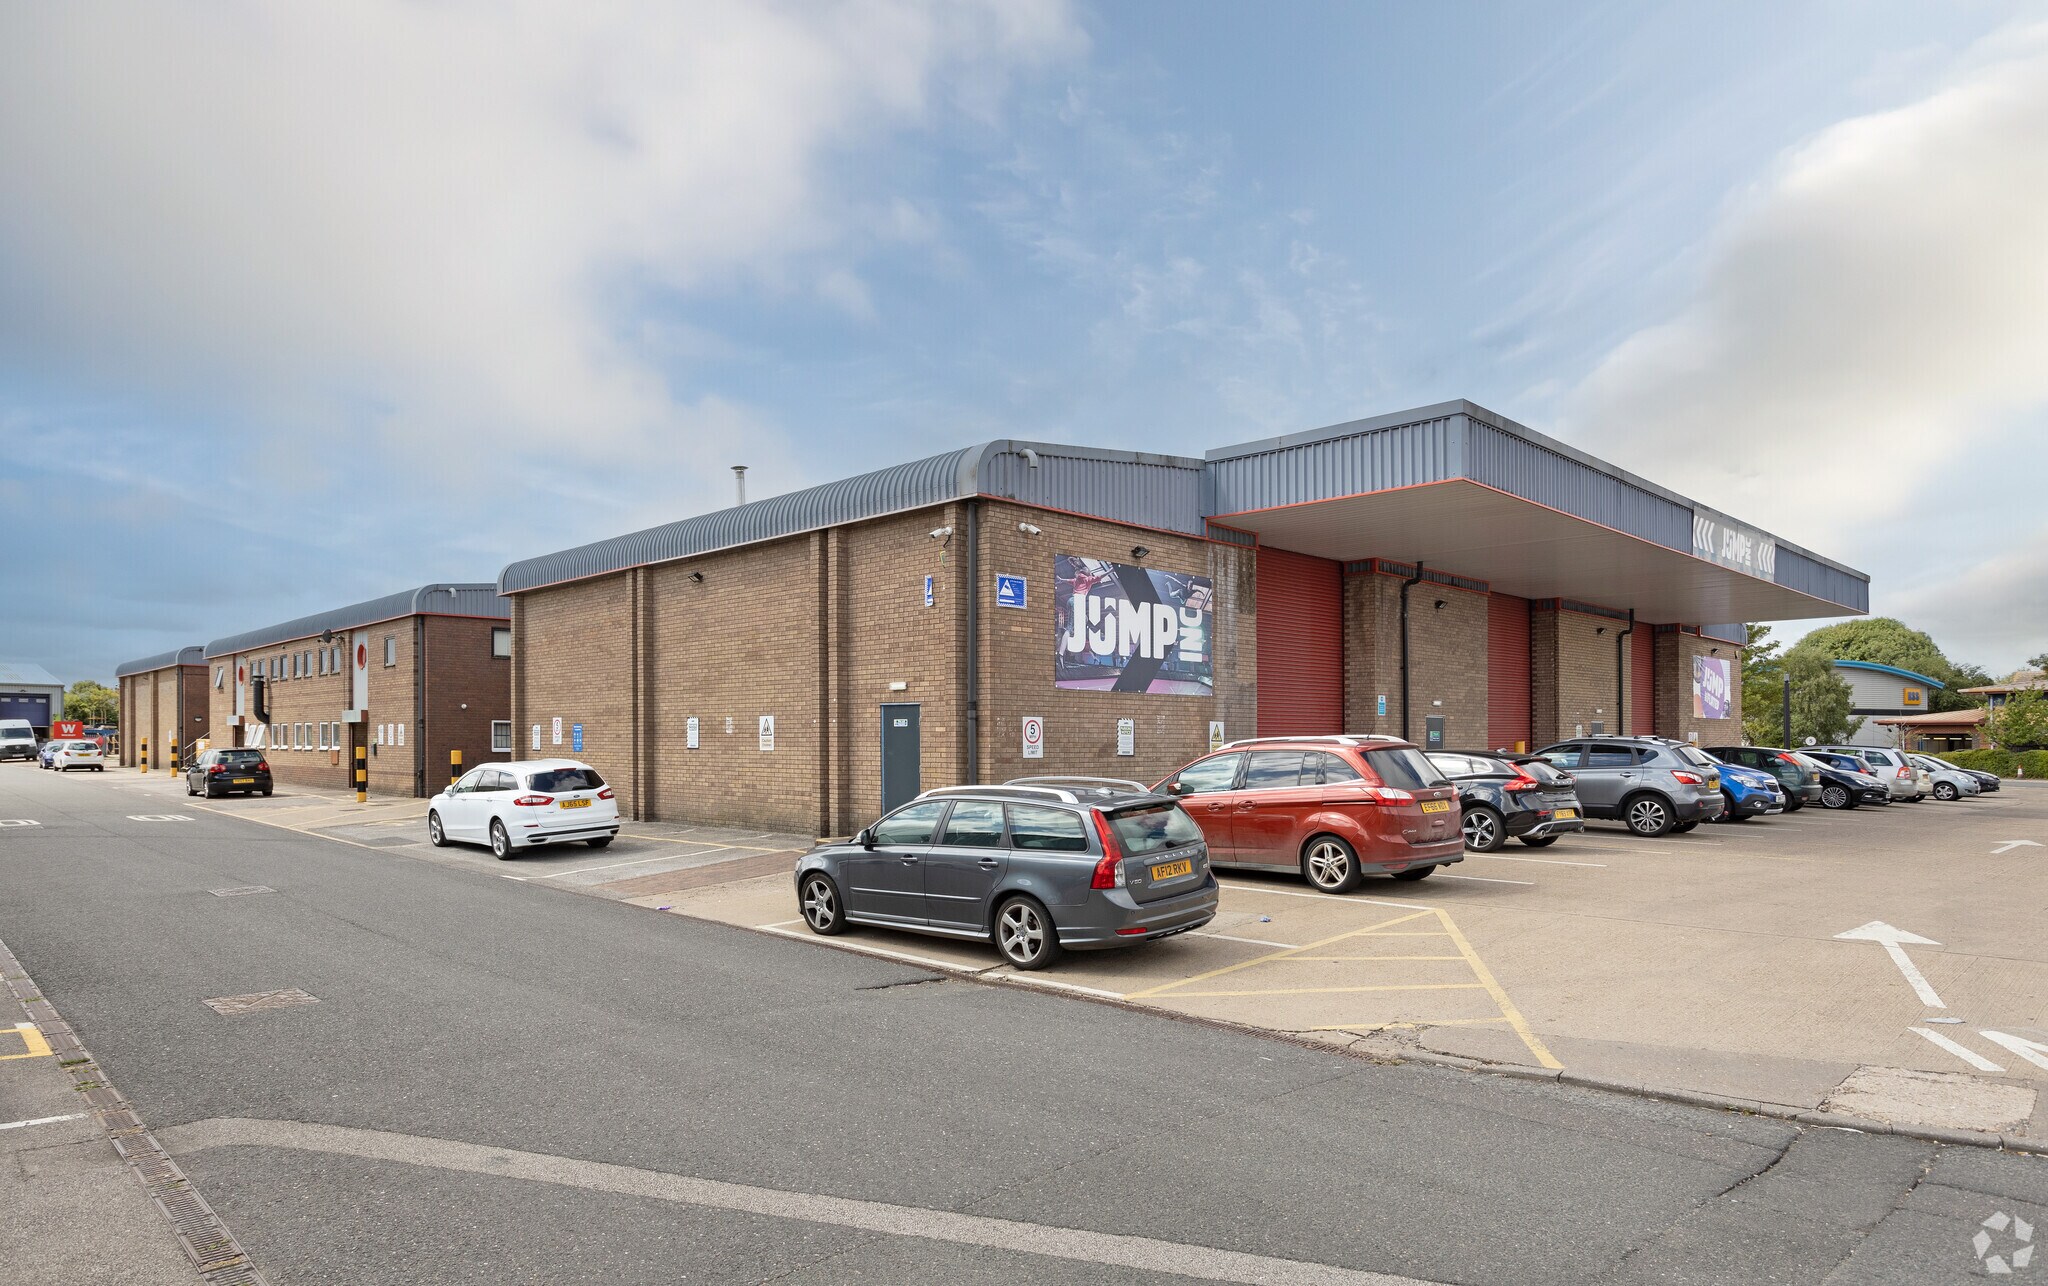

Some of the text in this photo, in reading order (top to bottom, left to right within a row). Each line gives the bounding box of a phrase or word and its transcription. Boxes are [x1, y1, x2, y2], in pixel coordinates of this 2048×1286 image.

[1722, 527, 1746, 563] JUMP
[1067, 593, 1202, 662] JUMP INC
[1703, 666, 1724, 698] JUMP
[61, 724, 77, 734] W
[1030, 724, 1036, 735] 5
[1156, 850, 1190, 860] VOLVO
[1156, 861, 1187, 878] AF12 RKV
